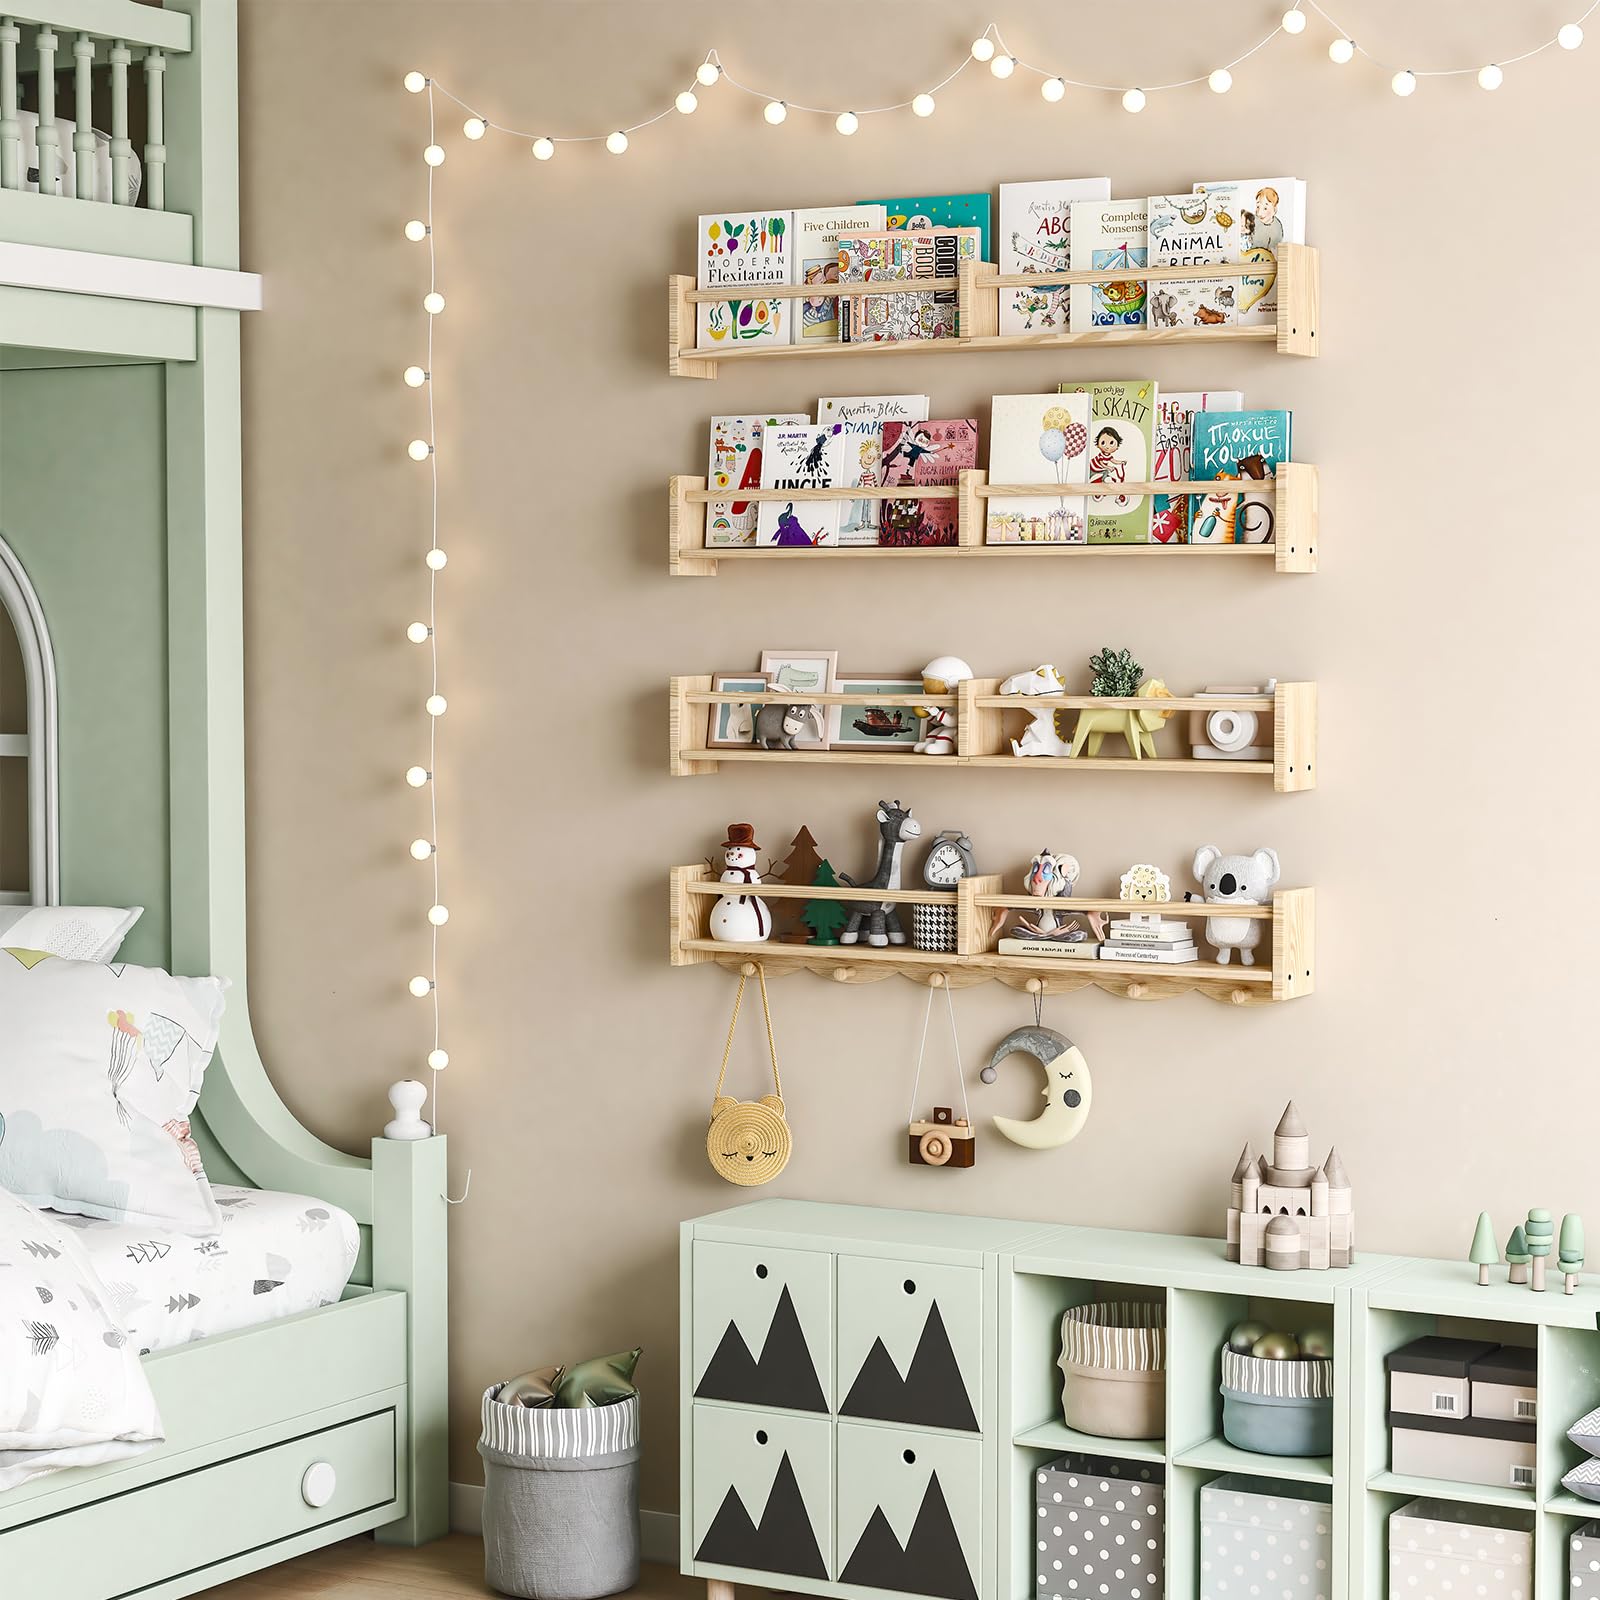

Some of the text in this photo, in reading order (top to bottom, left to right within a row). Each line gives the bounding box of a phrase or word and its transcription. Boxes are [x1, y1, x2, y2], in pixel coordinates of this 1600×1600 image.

[1101, 211, 1148, 223] Complete
[804, 219, 869, 231] Five Children
[1101, 224, 1148, 234] Nonsense
[708, 256, 784, 268] MODERN
[708, 266, 783, 283] Flexitarian
[874, 402, 909, 419] Blake
[1102, 396, 1150, 423] SKATT
[1167, 422, 1182, 434] the
[774, 478, 832, 489] UNCLE
[1137, 952, 1159, 960] Canterbury
